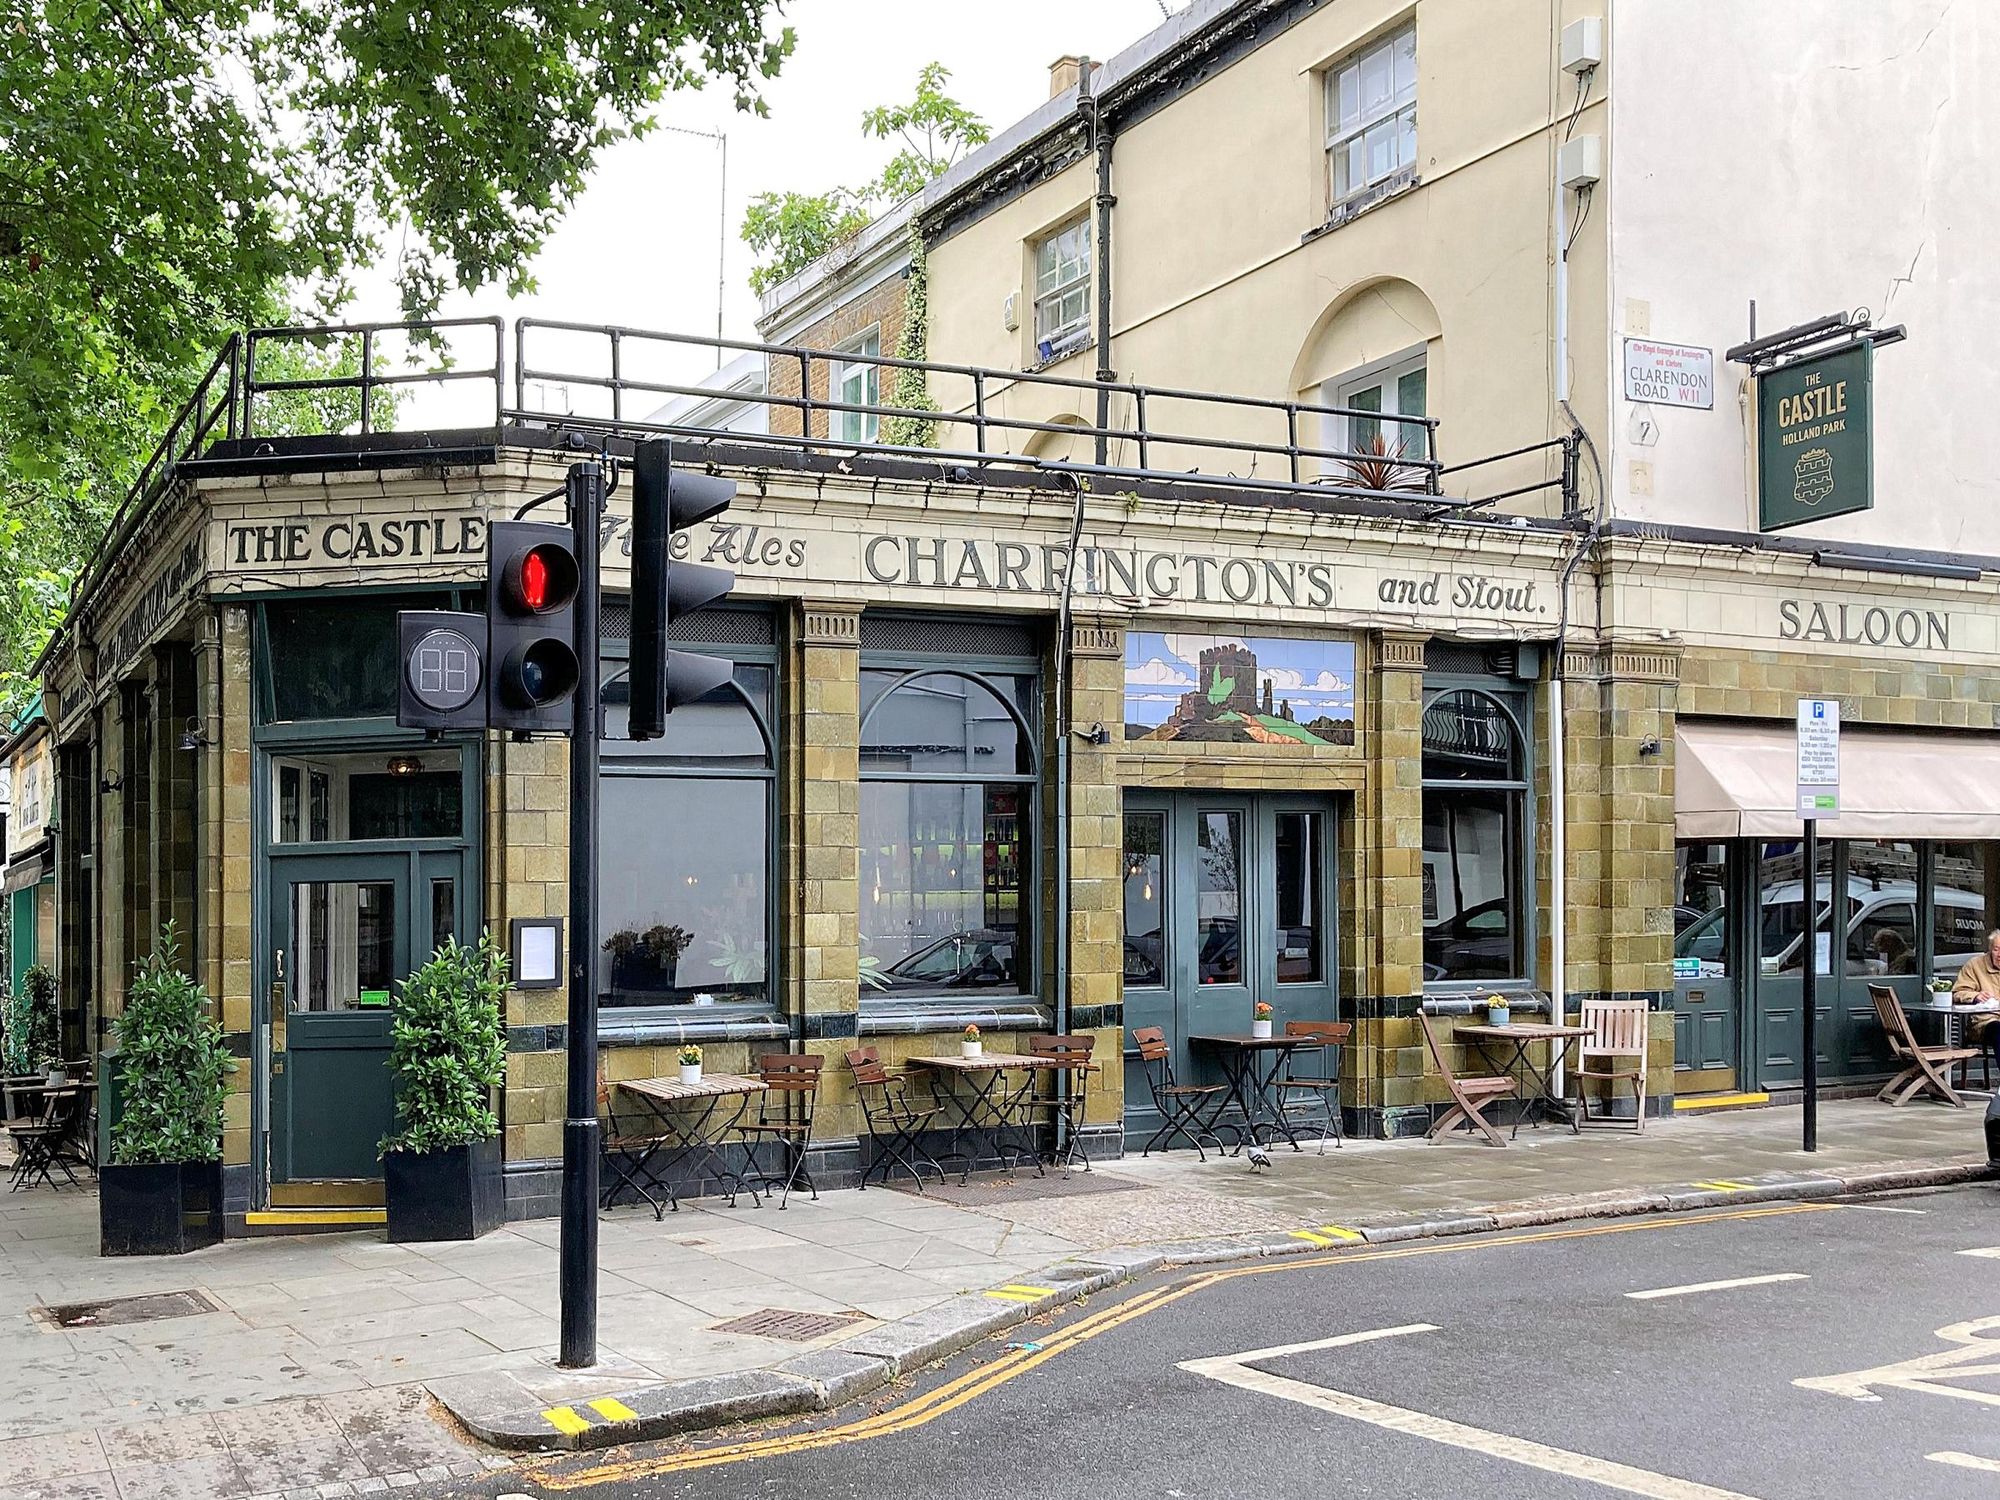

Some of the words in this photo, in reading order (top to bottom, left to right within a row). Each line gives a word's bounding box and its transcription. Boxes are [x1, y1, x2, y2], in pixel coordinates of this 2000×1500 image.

[1630, 366, 1707, 388] CLARENDON
[1805, 372, 1821, 386] THE
[1778, 381, 1847, 428] CASTLE
[1782, 425, 1821, 446] HOLLAND
[1823, 419, 1846, 436] PARK
[229, 525, 312, 564] THE
[322, 516, 485, 559] CASTLE
[600, 516, 690, 560] Fie
[700, 524, 807, 567] Ales
[865, 536, 1332, 607] CHARRINGTON'S
[1378, 573, 1440, 605] and
[1452, 575, 1546, 613] Stout.
[1780, 599, 1950, 650] SALOON
[1814, 703, 1823, 718] P
